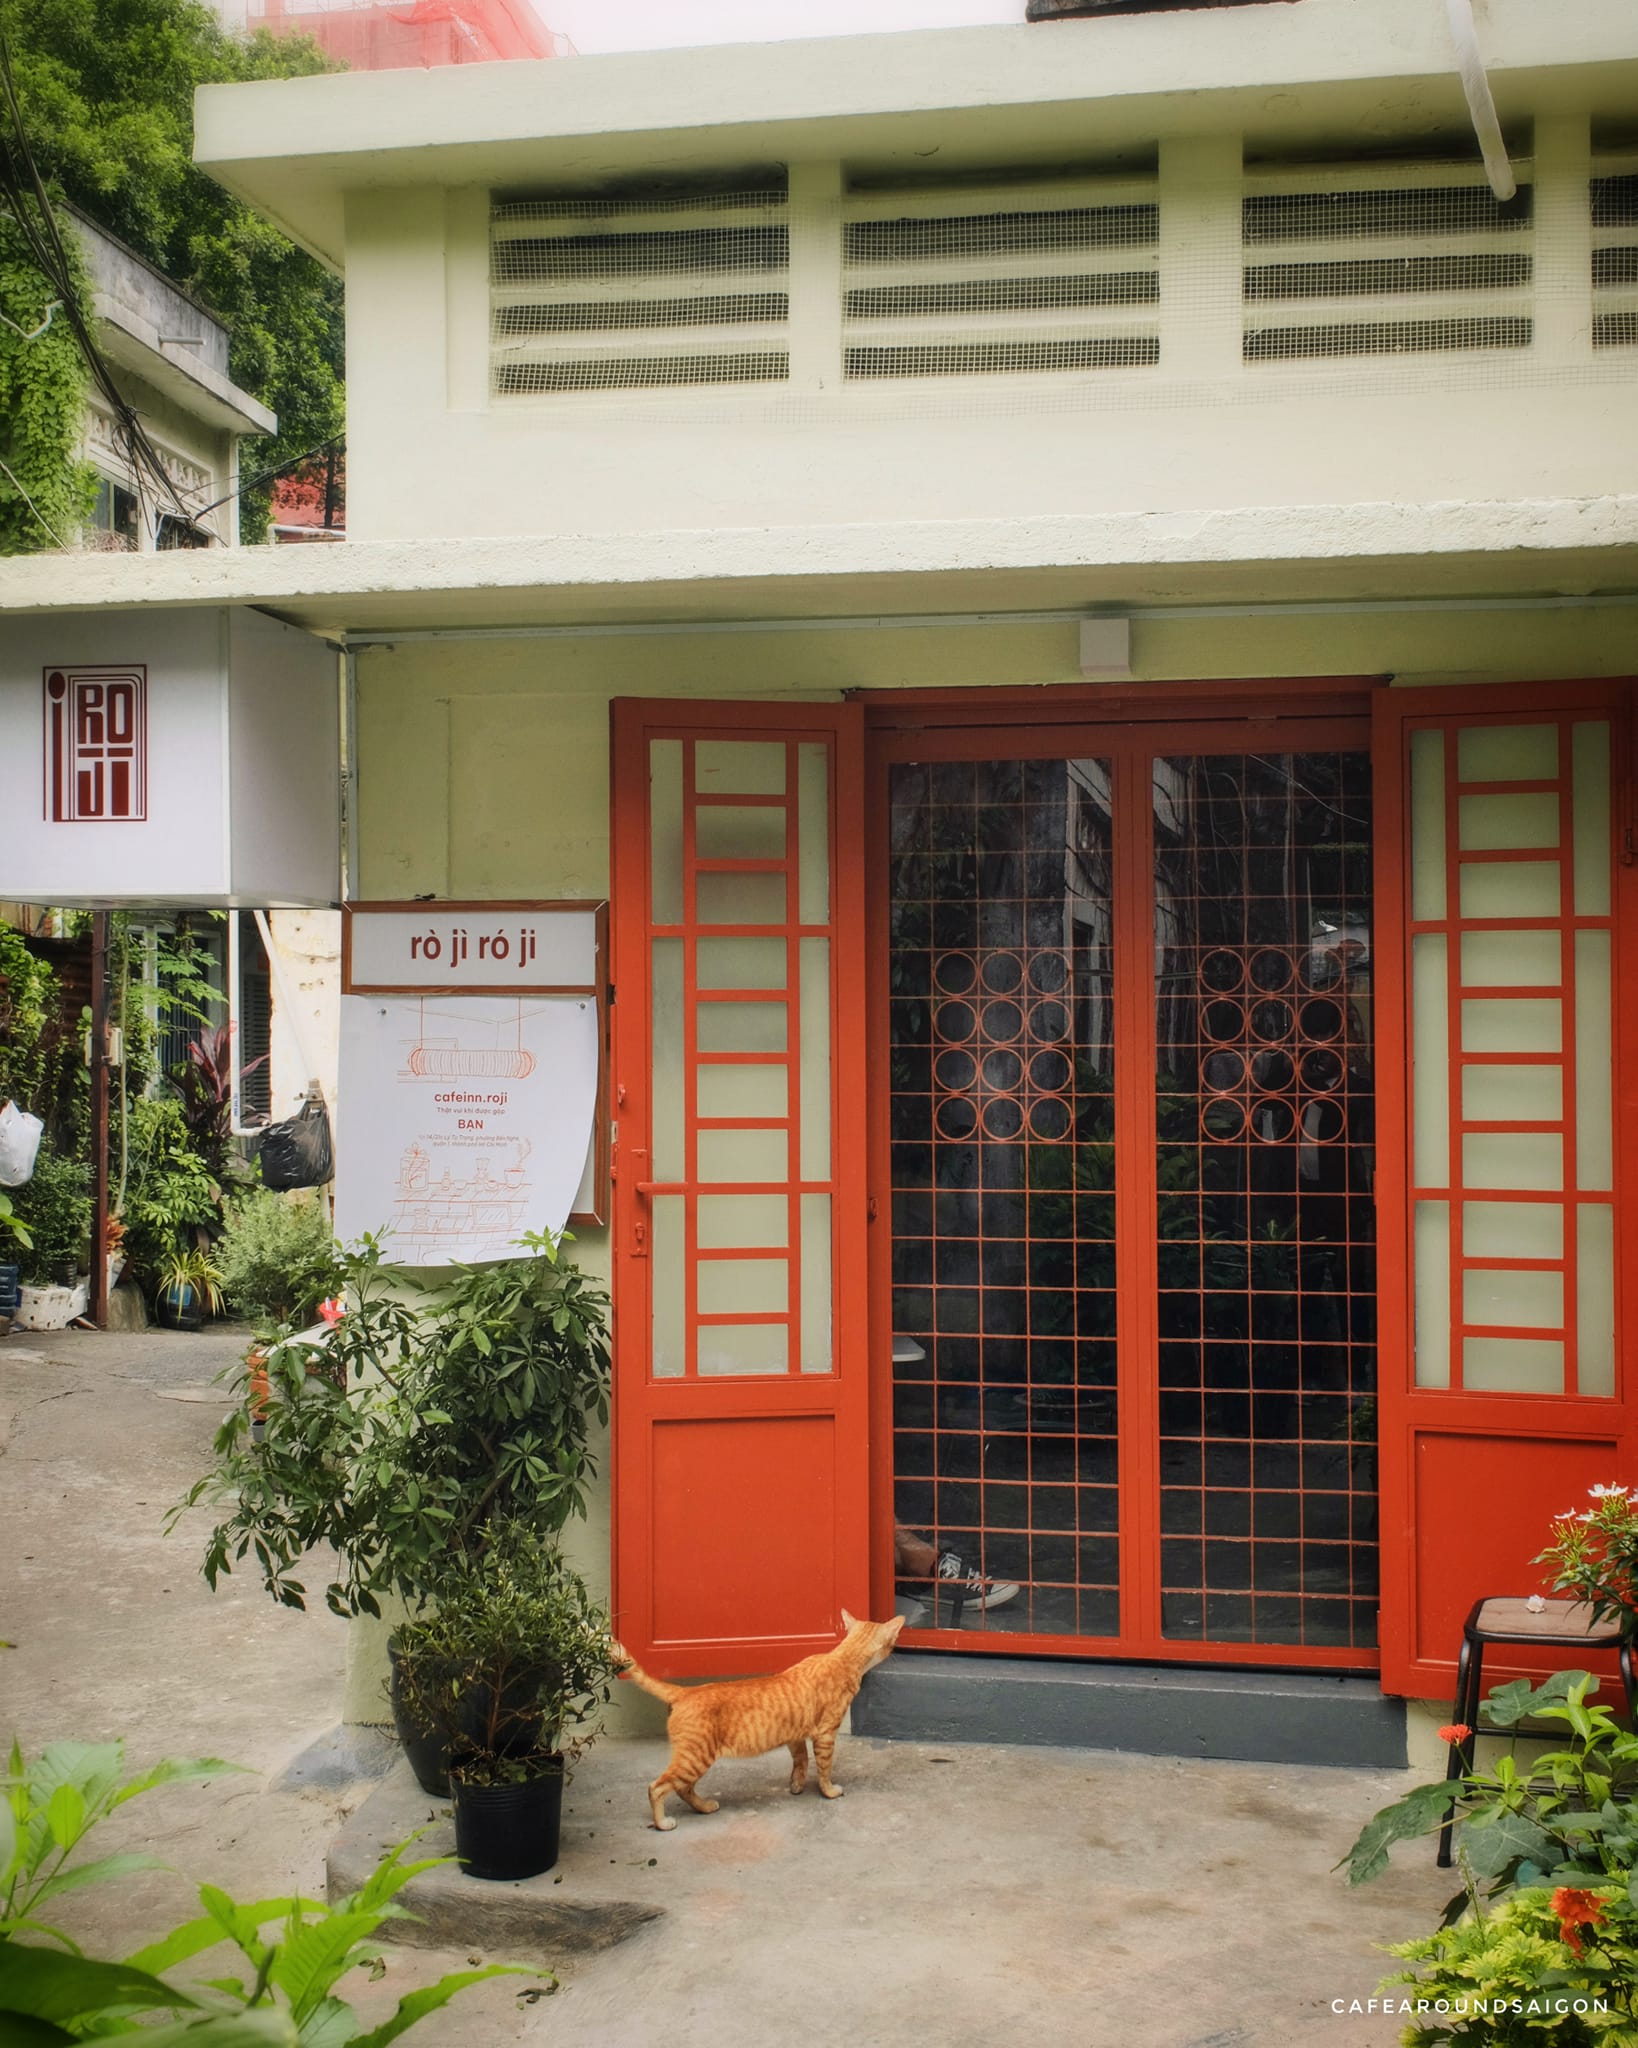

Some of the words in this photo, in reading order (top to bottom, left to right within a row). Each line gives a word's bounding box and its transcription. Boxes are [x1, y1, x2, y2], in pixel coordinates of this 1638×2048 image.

[411, 929, 441, 960] rò
[450, 929, 468, 968] jì
[479, 929, 509, 960] ró
[518, 928, 536, 968] ji
[434, 1091, 508, 1106] cafeinn.roji
[458, 1119, 484, 1132] BẠN
